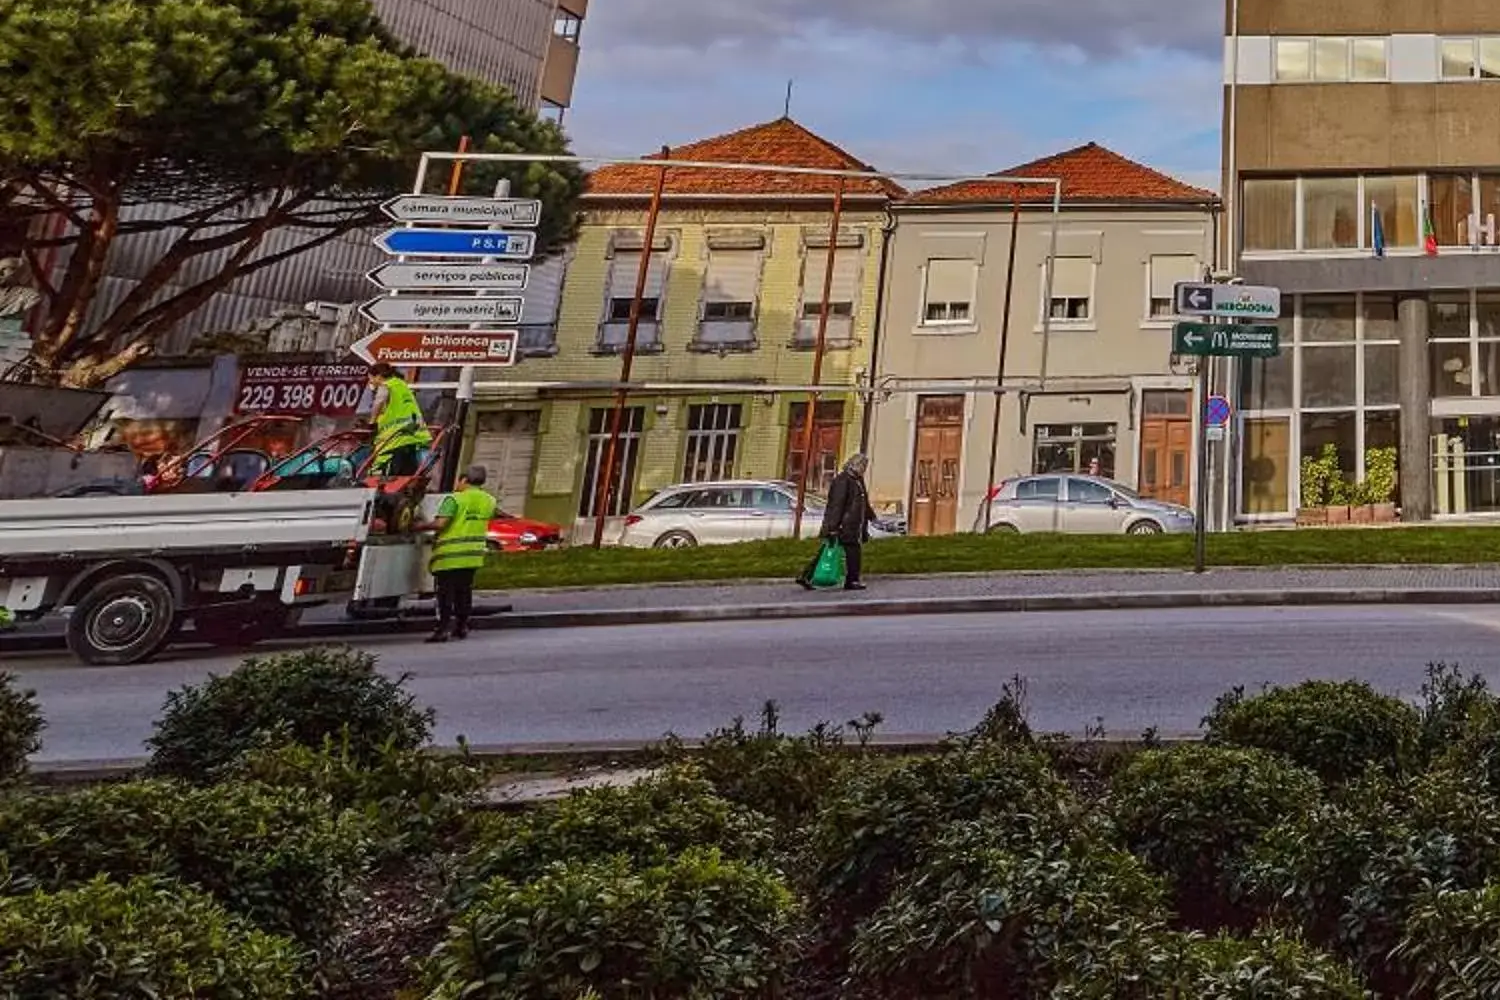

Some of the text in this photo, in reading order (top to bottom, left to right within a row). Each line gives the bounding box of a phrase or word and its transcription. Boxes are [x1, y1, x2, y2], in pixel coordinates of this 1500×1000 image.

[452, 206, 513, 216] municipal
[415, 271, 466, 282] serviços
[454, 304, 495, 315] matriz
[421, 335, 489, 346] biblioteca
[247, 366, 309, 377] VENDE-SE
[239, 383, 360, 409] 229 398 000
